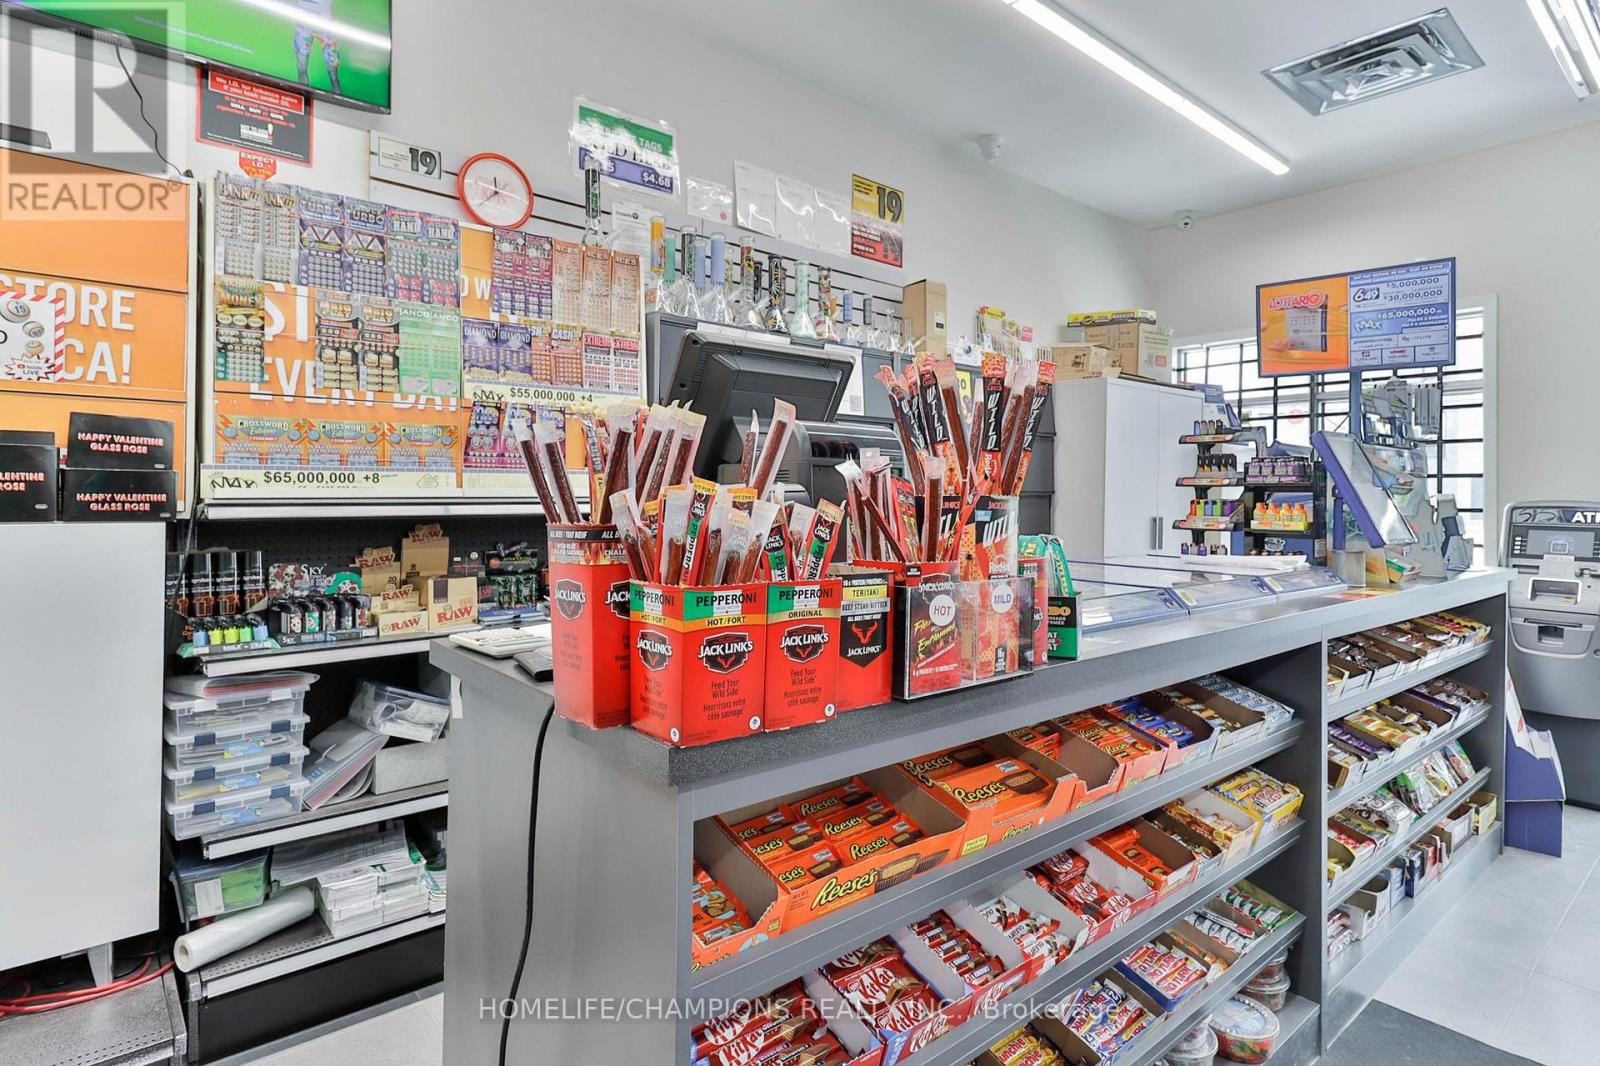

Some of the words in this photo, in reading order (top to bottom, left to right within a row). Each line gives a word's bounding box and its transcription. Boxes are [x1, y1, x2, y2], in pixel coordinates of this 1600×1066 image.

[638, 138, 663, 152] TAGS
[241, 152, 274, 164] EXPECT
[408, 148, 438, 176] 19
[642, 171, 671, 187] $4.68
[877, 186, 902, 223] 19
[0, 276, 136, 331] TORE
[1269, 292, 1321, 309] LOTTARIO
[430, 312, 459, 322] ANCO
[464, 327, 497, 339] DIAMOND
[500, 330, 531, 343] DIAMOND
[552, 328, 572, 340] CASH
[510, 387, 575, 402] $55,000,000
[927, 385, 944, 440] WILD
[237, 419, 289, 431] CROSSWORD
[320, 422, 366, 433] CROSSWORD
[987, 392, 1000, 451] WILD
[1023, 396, 1045, 451] WILD
[400, 426, 442, 436] CROSSWORD
[77, 432, 111, 443] HAPPY
[113, 434, 164, 447] VALENTINE
[90, 442, 122, 452] GLASS
[123, 444, 148, 454] ROSE
[0, 471, 44, 482] LENTINE
[263, 471, 356, 485] $65,000,000
[76, 493, 111, 503] HAPPY
[113, 493, 167, 503] VALENTINE
[90, 502, 122, 511] GLASS
[124, 502, 150, 511] ROSE
[601, 531, 614, 539] ALL
[358, 554, 394, 569] RAW
[807, 544, 825, 580] PEPPER
[301, 563, 324, 575] SKY
[382, 588, 411, 601] RAW
[605, 591, 630, 604] JACK
[634, 589, 674, 607] PEPPERONI
[779, 588, 833, 601] PEPPERONI
[852, 588, 880, 597] TERIYAKI
[994, 594, 1011, 604] MILD
[696, 593, 756, 607] PEPPERONI
[437, 605, 473, 623] RAW
[788, 610, 822, 619] ORIGINAL
[934, 605, 951, 616] HOT
[391, 617, 421, 632] RAW
[780, 636, 802, 648] JACK
[698, 645, 723, 659] JACK
[847, 648, 863, 657] JACK
[711, 681, 726, 690] Feed
[726, 679, 740, 688] Your
[712, 689, 725, 699] Wild
[703, 701, 731, 712] Nourrissez
[732, 699, 746, 707] votre
[739, 827, 757, 840] se's
[753, 838, 784, 855] eese's
[779, 866, 805, 883] ese's
[810, 870, 878, 911] Reese's
[858, 968, 893, 999] KitKat
[889, 1000, 922, 1033] KitKat
[998, 1037, 1026, 1063] unchie
